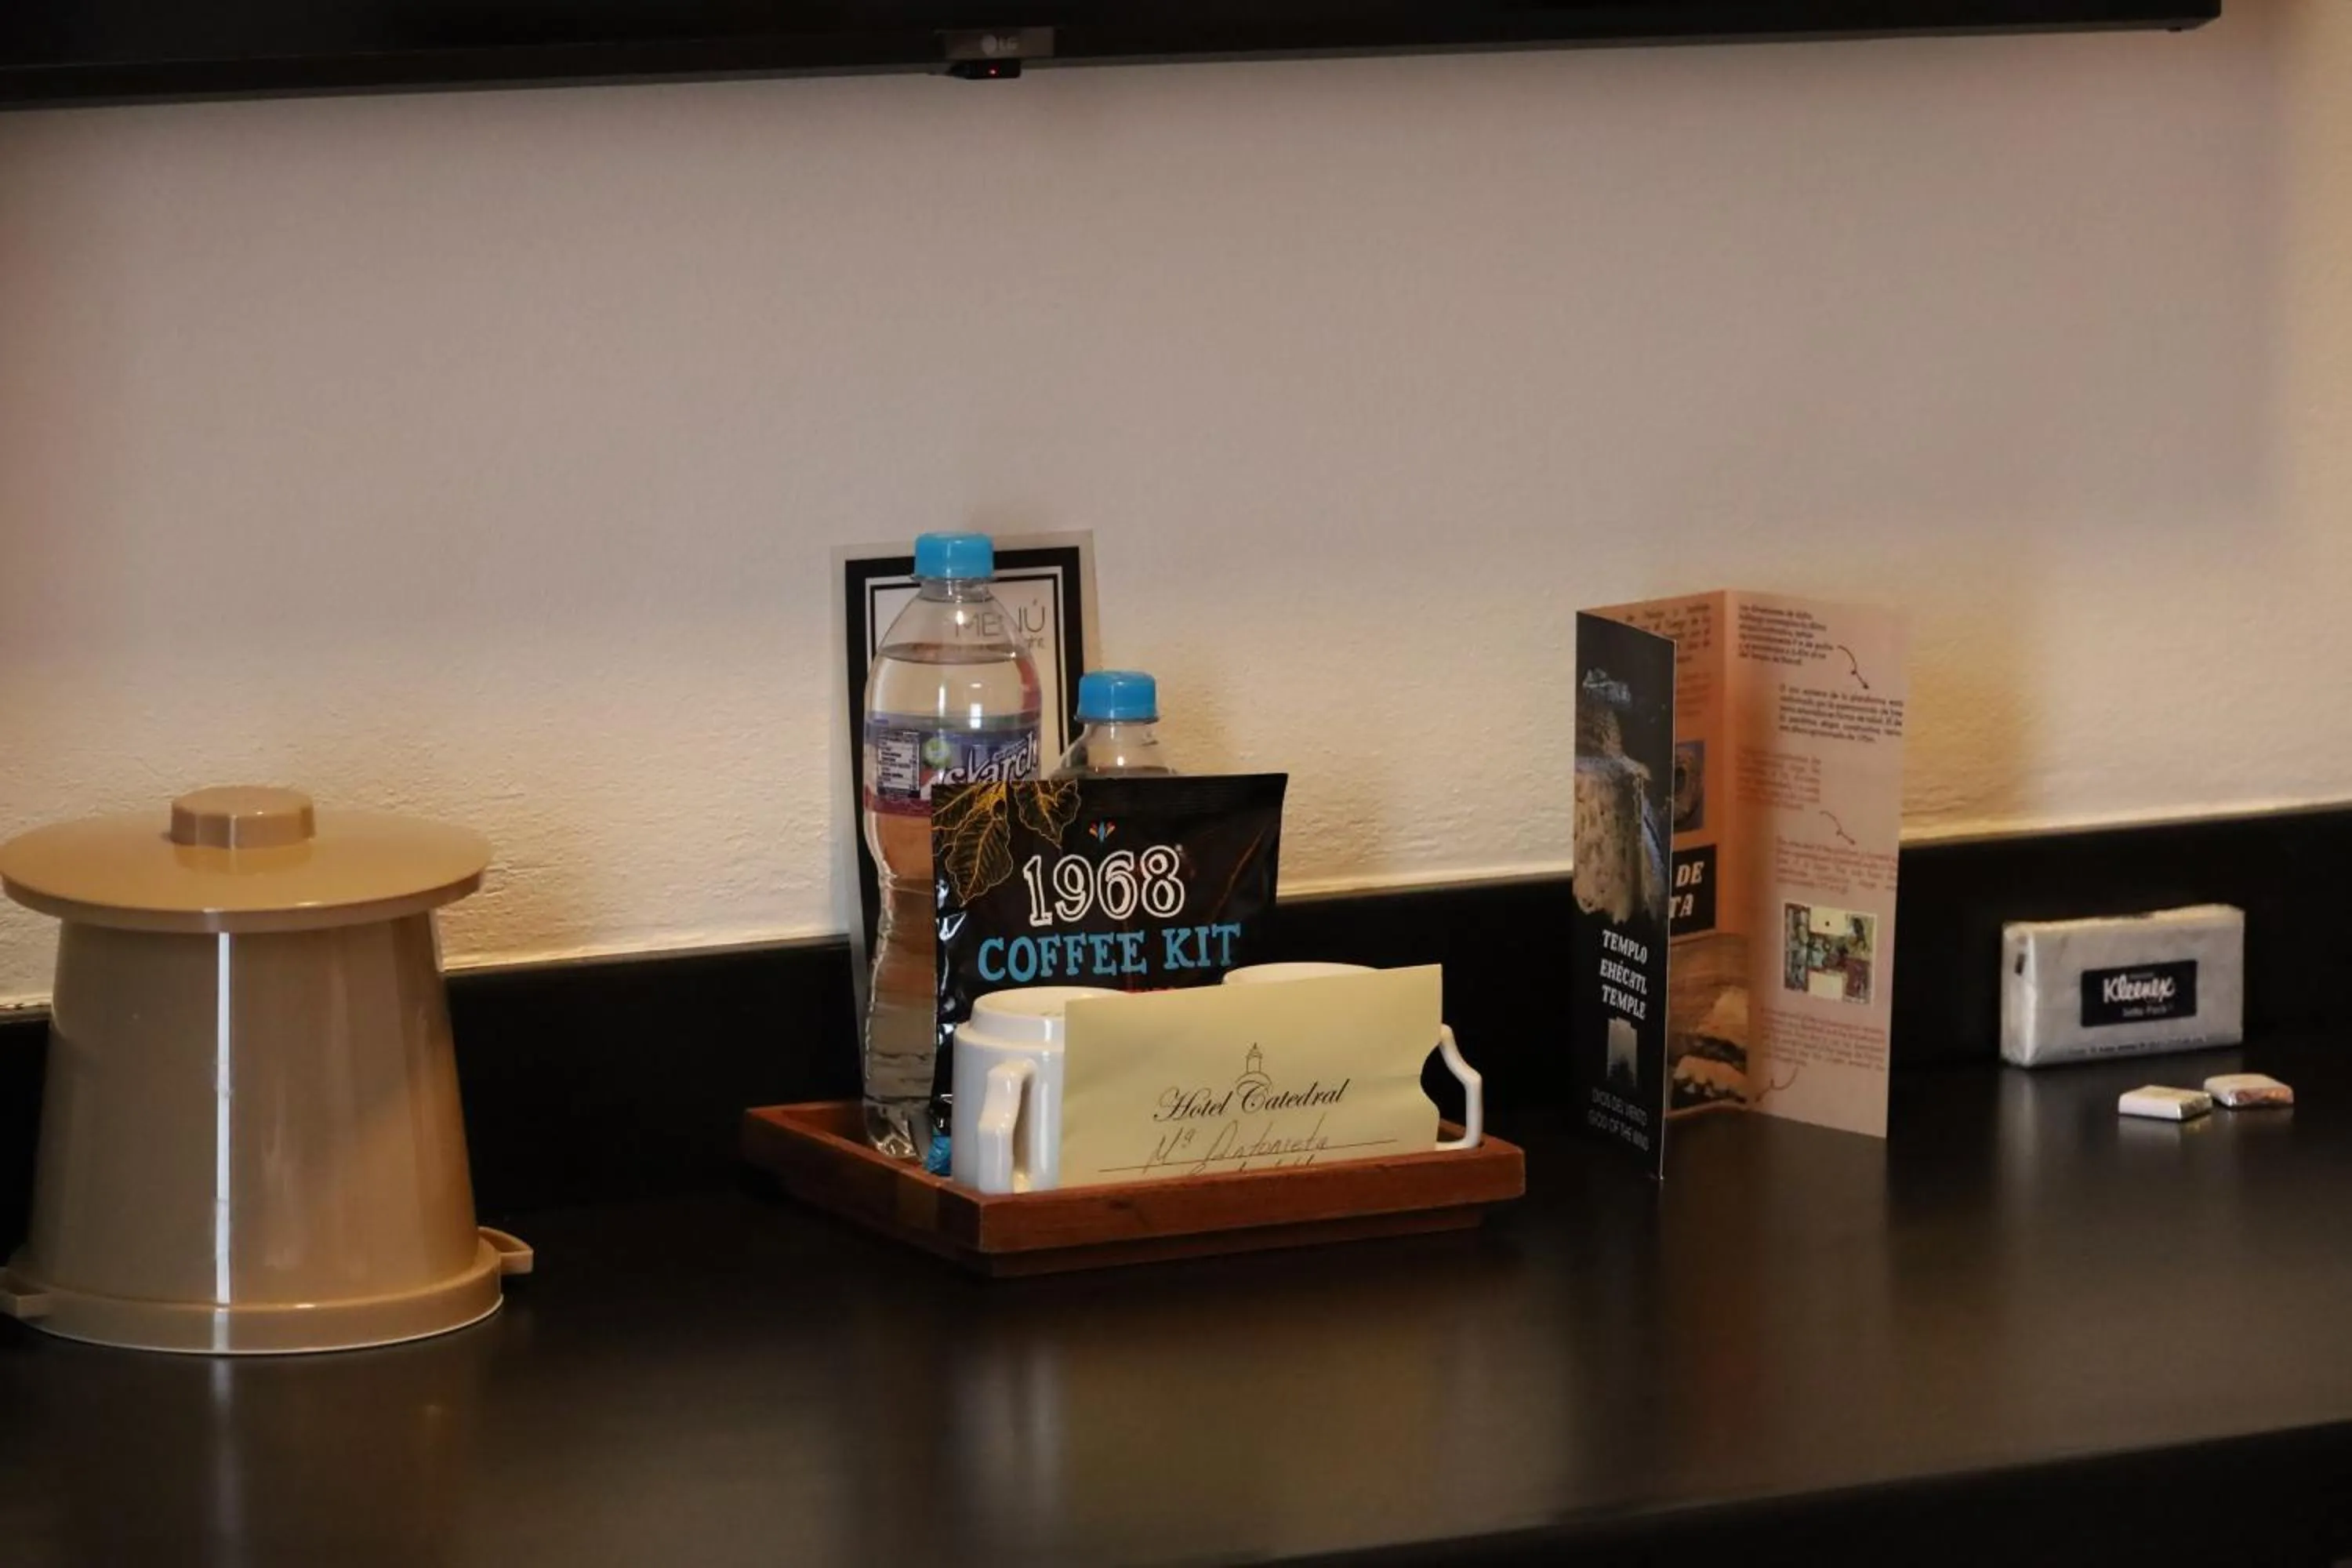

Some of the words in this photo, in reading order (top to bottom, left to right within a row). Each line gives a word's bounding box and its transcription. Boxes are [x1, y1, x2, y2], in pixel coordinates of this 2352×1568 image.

[1022, 844, 1185, 927] 1968
[1675, 861, 1704, 887] DE
[978, 930, 1148, 982] COFFEE
[1162, 923, 1241, 971] KIT
[1602, 928, 1647, 964] TEMPLO
[1600, 958, 1647, 995] EHÉCATL
[2103, 974, 2176, 1003] Kleenex
[1602, 984, 1646, 1020] TEMPLE
[1153, 1087, 1233, 1122] Hotel
[1236, 1079, 1350, 1114] Catedral
